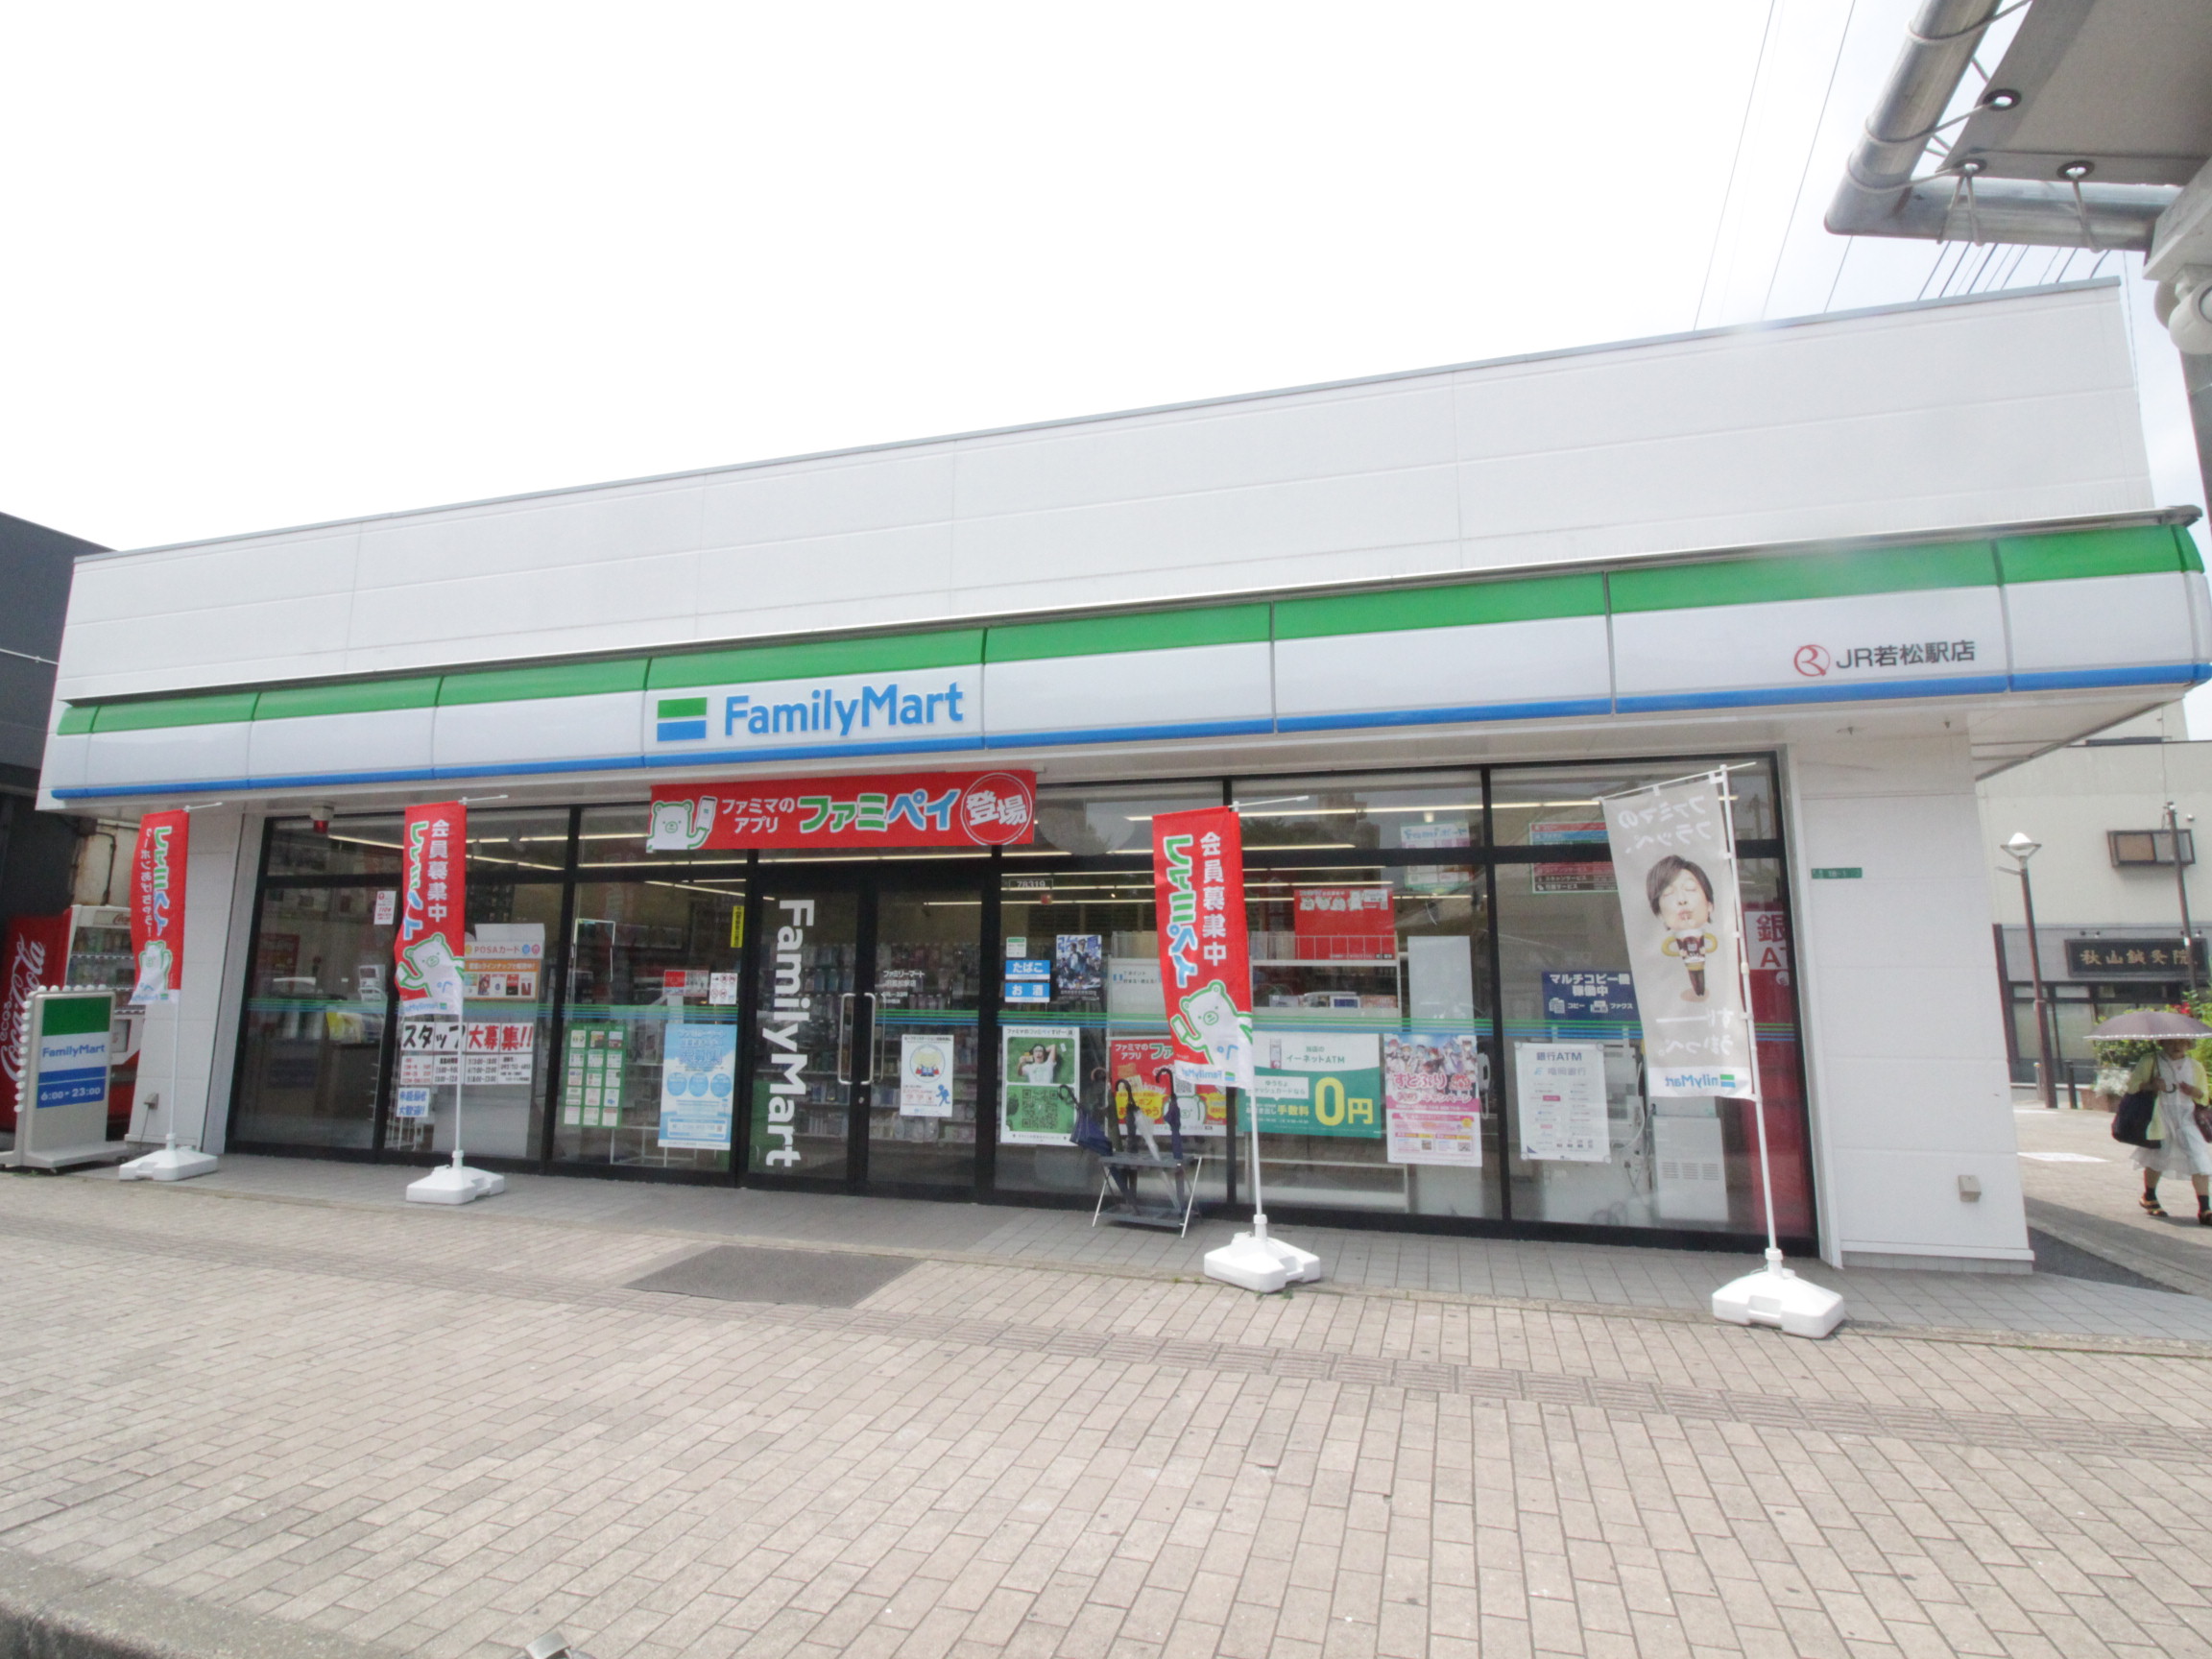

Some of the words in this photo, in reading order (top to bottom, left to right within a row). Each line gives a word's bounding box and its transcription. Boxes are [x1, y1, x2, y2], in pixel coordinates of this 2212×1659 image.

[1836, 639, 1976, 669] JR若松駅店
[725, 682, 963, 736] FamilyMart
[722, 797, 795, 814] ファミマの
[797, 788, 960, 833] ファミペイ
[966, 790, 1028, 826] 登場
[734, 816, 779, 833] アプリ
[883, 970, 926, 978] ファミリーマート
[1013, 961, 1044, 974] たばこ
[1550, 973, 1630, 985] マルチコピー機
[762, 899, 815, 1167] FamilyMart
[42, 1044, 106, 1057] FamilyMart
[1121, 1051, 1142, 1060] アプリ
[1537, 1051, 1582, 1061] 銀行ATM
[1286, 1054, 1345, 1064] イーネットATM
[1249, 1087, 1306, 1095] ャッシュカードなら
[1315, 1077, 1374, 1126] 0円
